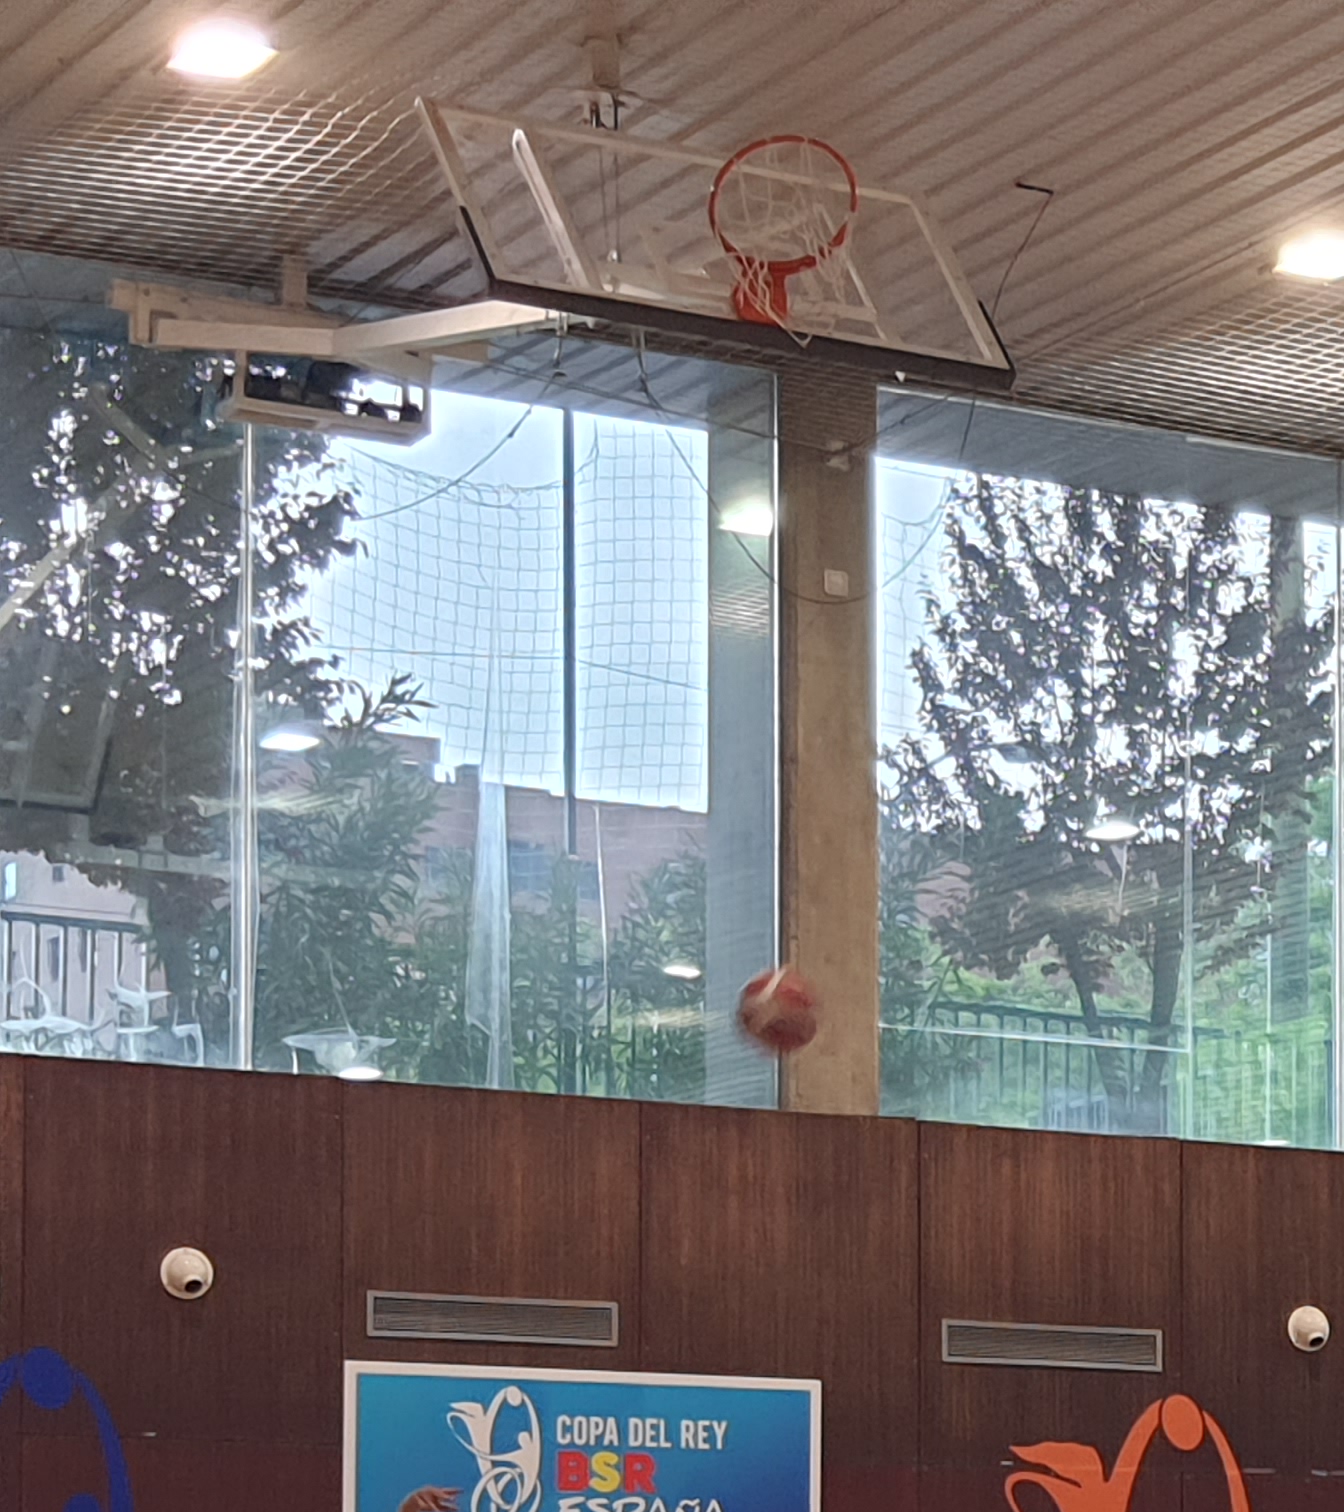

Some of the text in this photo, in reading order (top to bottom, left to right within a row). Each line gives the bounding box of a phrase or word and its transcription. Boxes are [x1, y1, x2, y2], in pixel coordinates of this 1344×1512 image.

[556, 1415, 728, 1450] COPA DEL REY
[556, 1451, 657, 1493] BSR
